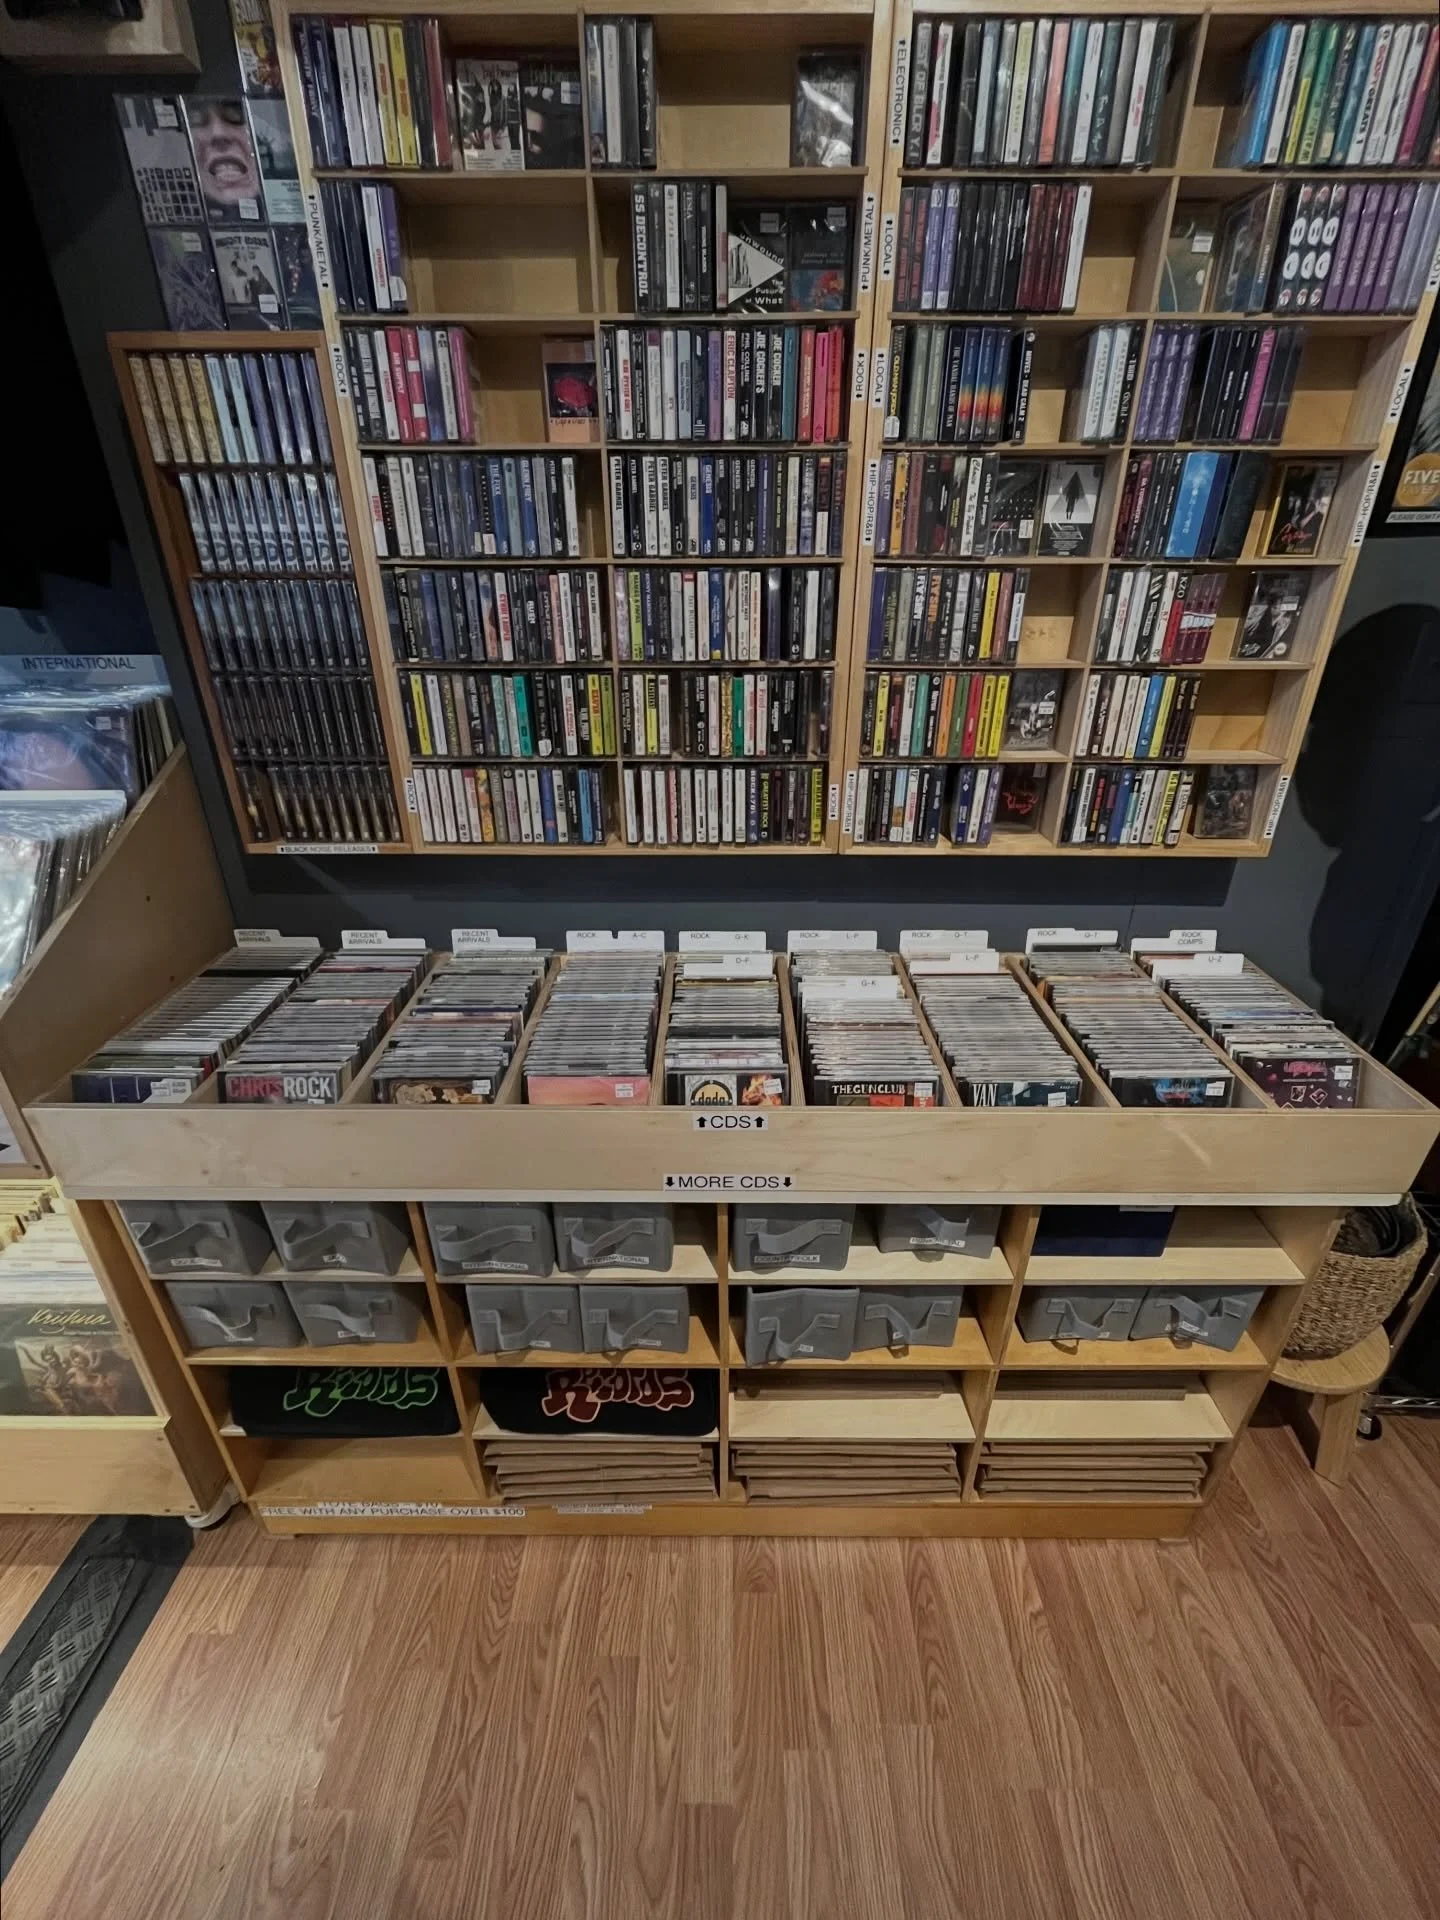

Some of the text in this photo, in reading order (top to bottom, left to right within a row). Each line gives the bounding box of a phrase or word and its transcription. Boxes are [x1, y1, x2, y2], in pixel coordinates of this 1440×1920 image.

[893, 47, 907, 139] ELECTRONIC
[1358, 89, 1379, 134] GREATS
[309, 202, 328, 280] PUNK/METAL
[634, 195, 649, 297] SS DECONTROL
[861, 203, 874, 283] PUNK/METAL
[883, 226, 894, 268] LOCAL
[755, 297, 783, 305] What
[757, 331, 766, 349] JOE
[952, 347, 961, 357] THE
[392, 352, 402, 365] AIR
[727, 335, 736, 399] ERIC CLAPTON
[773, 334, 782, 386] JOE COCKER
[1023, 350, 1033, 374] MOVES
[334, 355, 346, 387] ROCK
[855, 361, 865, 392] ROCK
[875, 361, 885, 396] LOCAL
[1390, 376, 1410, 411] LOCAL
[1019, 398, 1028, 417] CALM
[614, 459, 623, 511] PETER GABRIEL
[648, 461, 657, 513] PETER GABRIEL
[705, 464, 713, 494] GENESIS
[865, 469, 878, 536] HIP-HOP/R&B
[983, 495, 989, 503] of
[1354, 470, 1380, 538] HIP-HOP/R&B
[22, 656, 137, 671] INTERNATIONAL
[407, 784, 416, 806] ROCK
[829, 792, 838, 813] ROCK
[1037, 929, 1057, 937] ROCK
[735, 956, 750, 964] D-F
[1207, 955, 1222, 963] U-Z
[861, 979, 877, 987] G-K
[284, 1076, 333, 1100] ROCK
[698, 1091, 726, 1106] dada
[972, 1083, 998, 1107] VAN
[710, 1115, 752, 1129] CDS
[678, 1176, 780, 1188] MORE CDS
[464, 1262, 527, 1271] INTERNATIONAL
[584, 1254, 648, 1265] INTERNATIONAL
[262, 1507, 524, 1516] FREE WITH ANY PURCHASE OVER $100
